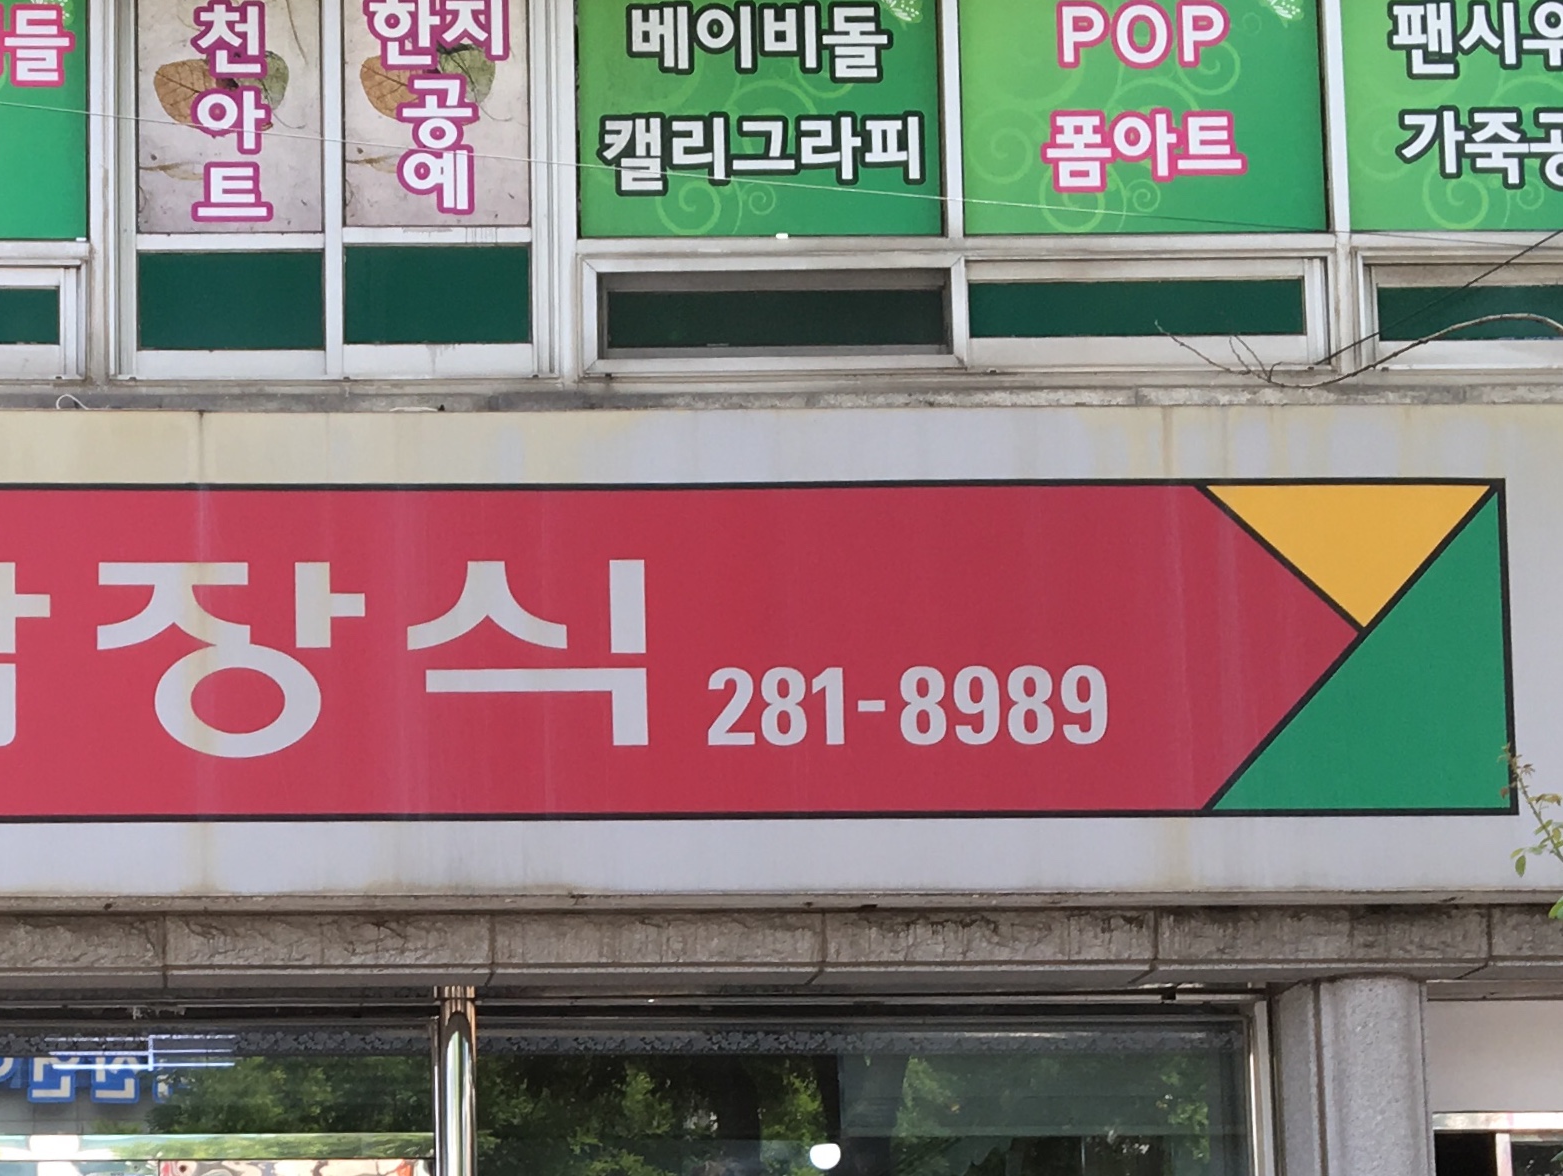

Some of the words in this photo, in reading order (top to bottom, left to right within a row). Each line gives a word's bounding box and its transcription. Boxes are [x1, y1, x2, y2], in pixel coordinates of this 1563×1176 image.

[630, 4, 890, 80] 베이비돌
[1060, 2, 1228, 66] POP
[195, 2, 270, 219] 천아트
[600, 114, 922, 193] 캘리그라피
[1044, 111, 1244, 189] 폼아트
[706, 663, 1109, 748] 281-8989
